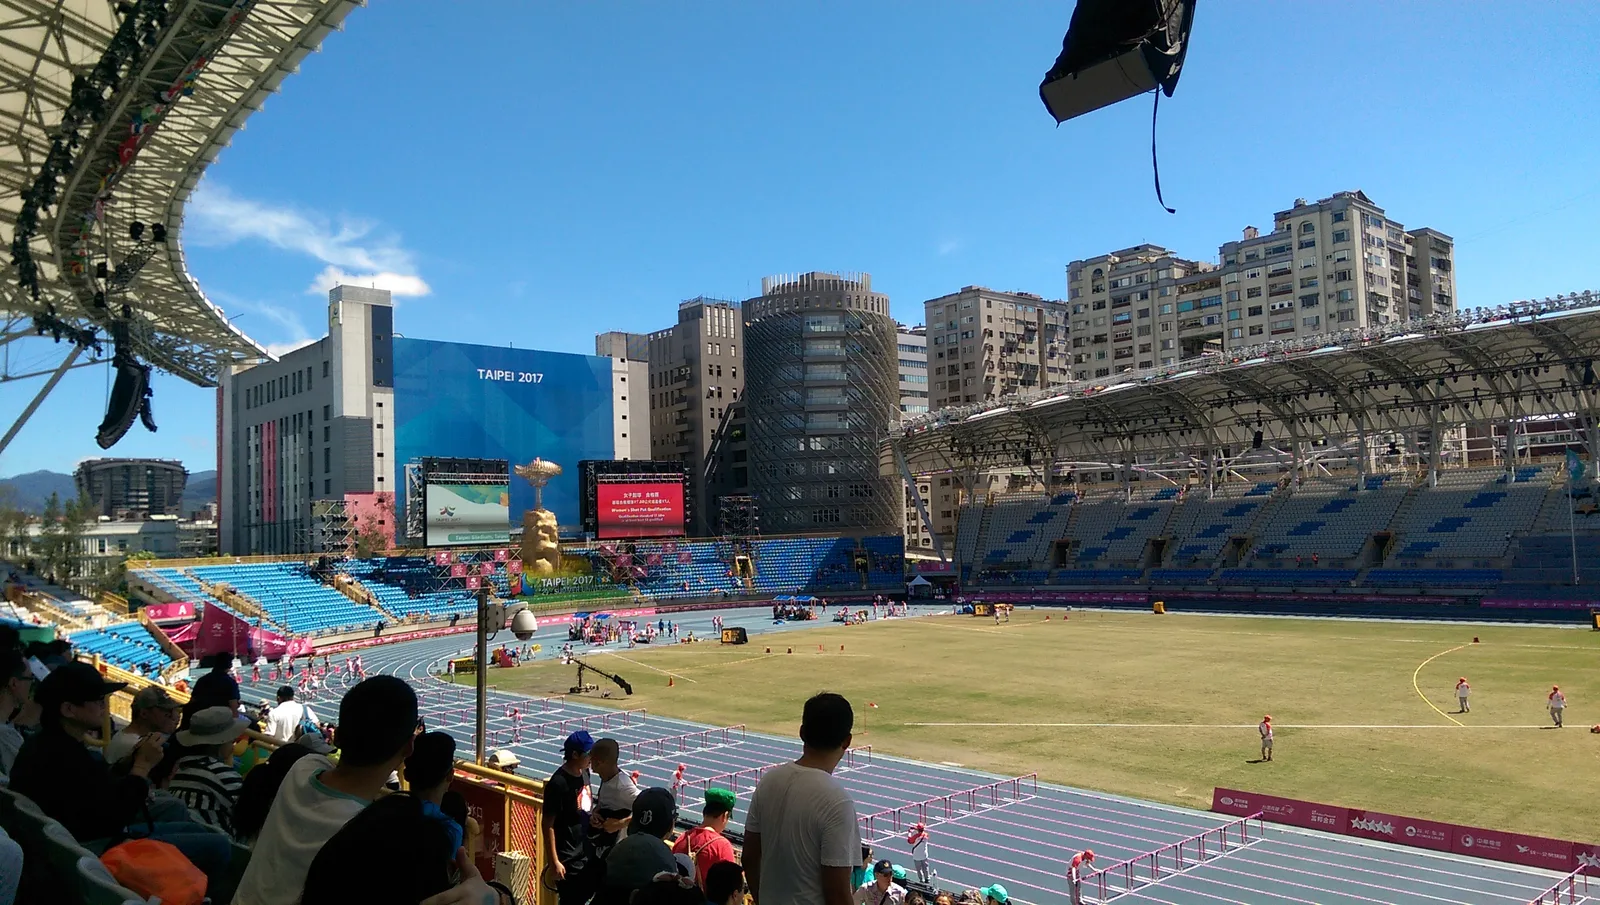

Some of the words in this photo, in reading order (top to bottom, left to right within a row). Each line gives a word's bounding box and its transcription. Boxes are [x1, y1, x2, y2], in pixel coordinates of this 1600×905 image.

[477, 368, 514, 381] TAIPEI
[518, 372, 543, 383] 2017
[541, 576, 570, 588] TAIPEI
[572, 575, 594, 586] 2017
[178, 605, 187, 615] A
[639, 809, 653, 826] B
